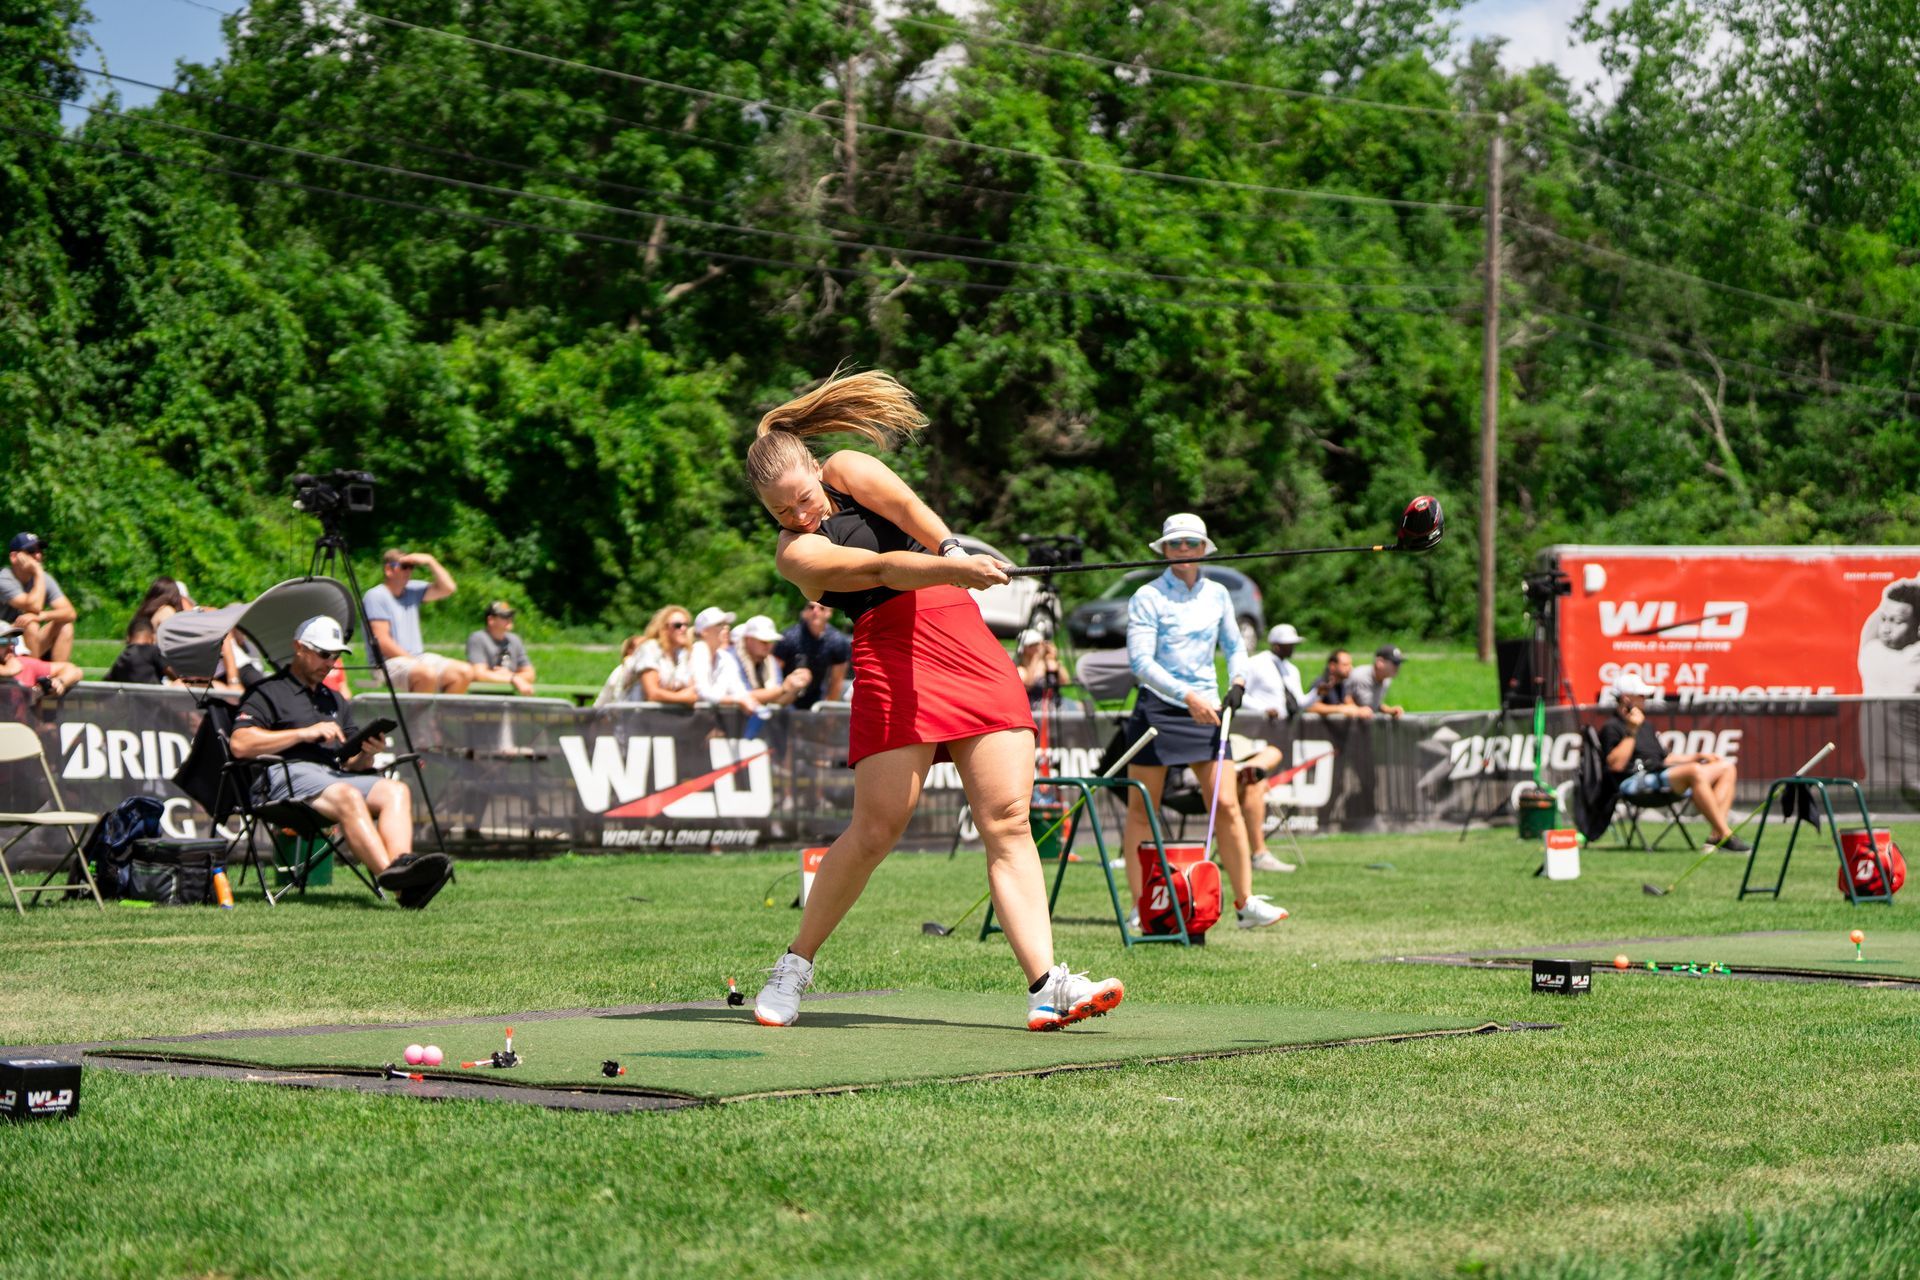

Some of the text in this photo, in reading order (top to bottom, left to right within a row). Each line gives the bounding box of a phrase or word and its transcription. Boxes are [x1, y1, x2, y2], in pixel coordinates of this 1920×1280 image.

[1598, 601, 1749, 640] WLD
[1674, 663, 1710, 685] AT
[60, 722, 195, 780] BRID
[559, 735, 775, 818] WLD
[602, 829, 761, 847] WORLD LONG DRIVE
[28, 1089, 73, 1107] WLD
